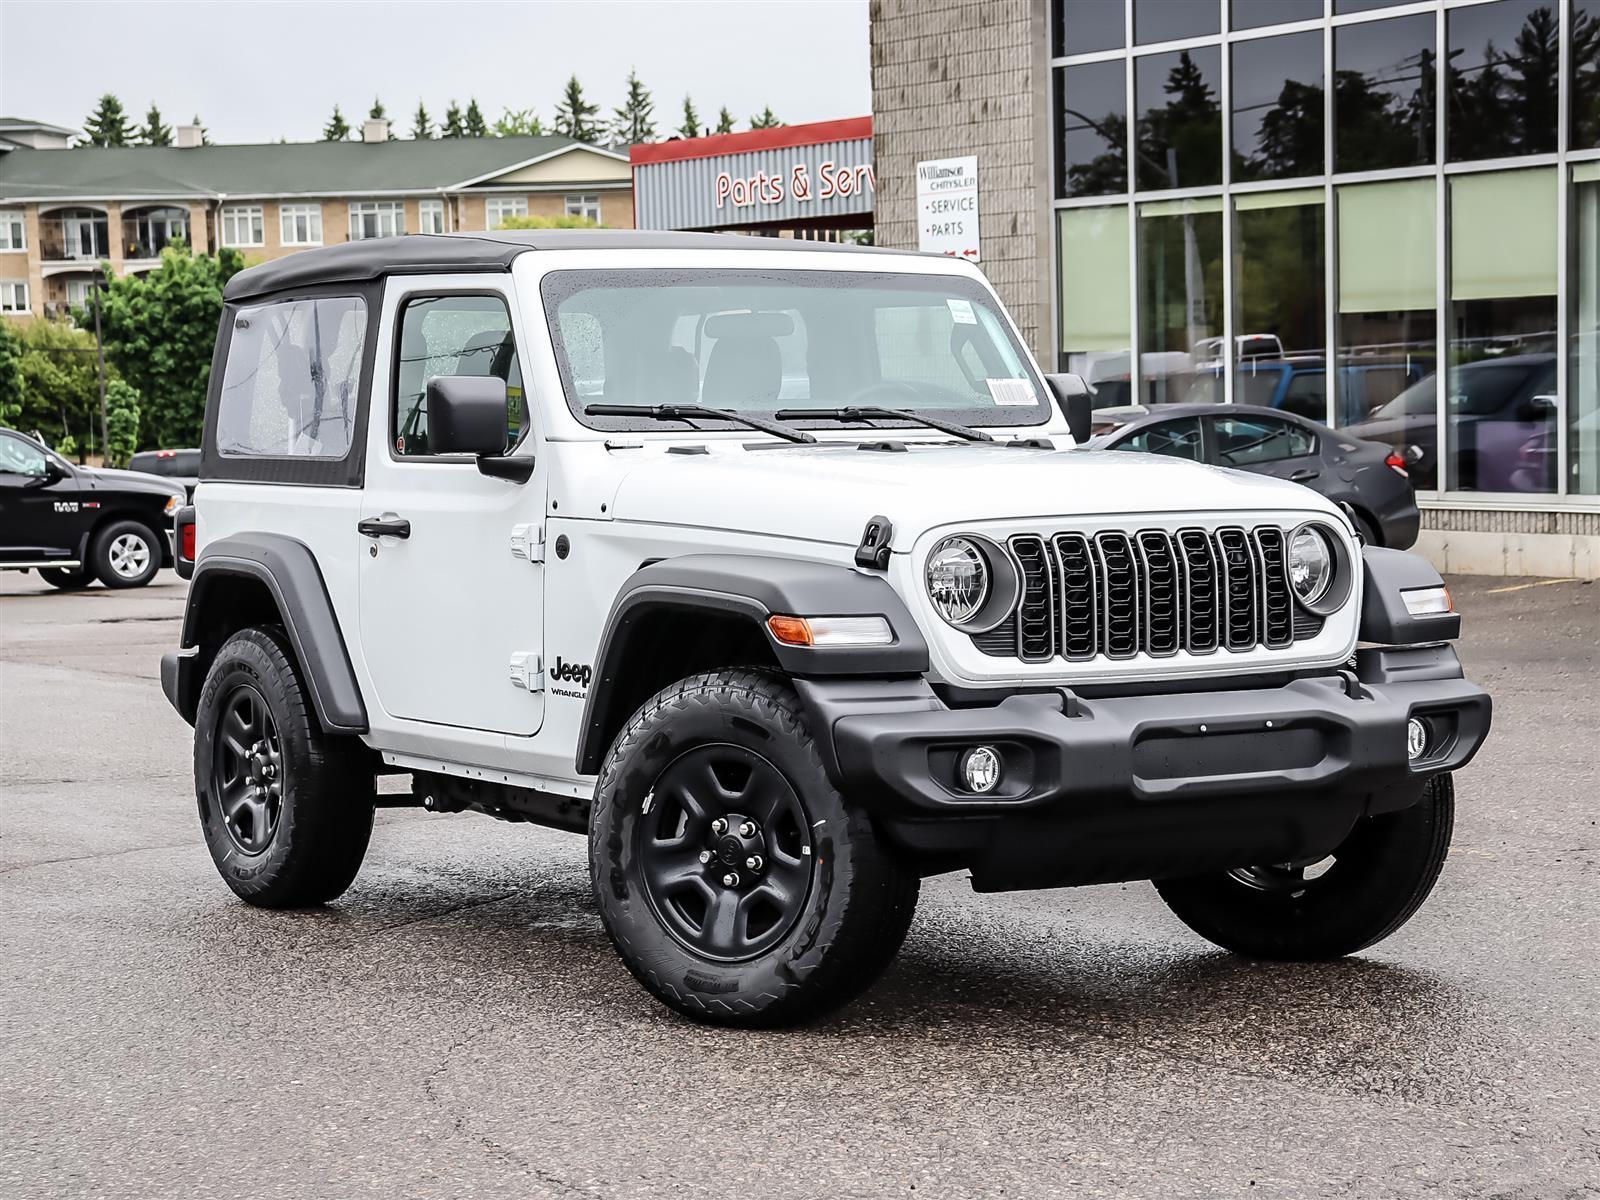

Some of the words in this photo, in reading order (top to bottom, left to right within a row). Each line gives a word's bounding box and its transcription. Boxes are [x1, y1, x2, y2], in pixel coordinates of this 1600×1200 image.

[919, 166, 963, 179] Williamson
[716, 172, 784, 208] Parts
[791, 163, 812, 201] &
[930, 177, 976, 190] CHRYSLER
[931, 197, 974, 213] SERVICE
[931, 222, 963, 236] PARTS
[550, 656, 592, 688] Jeep
